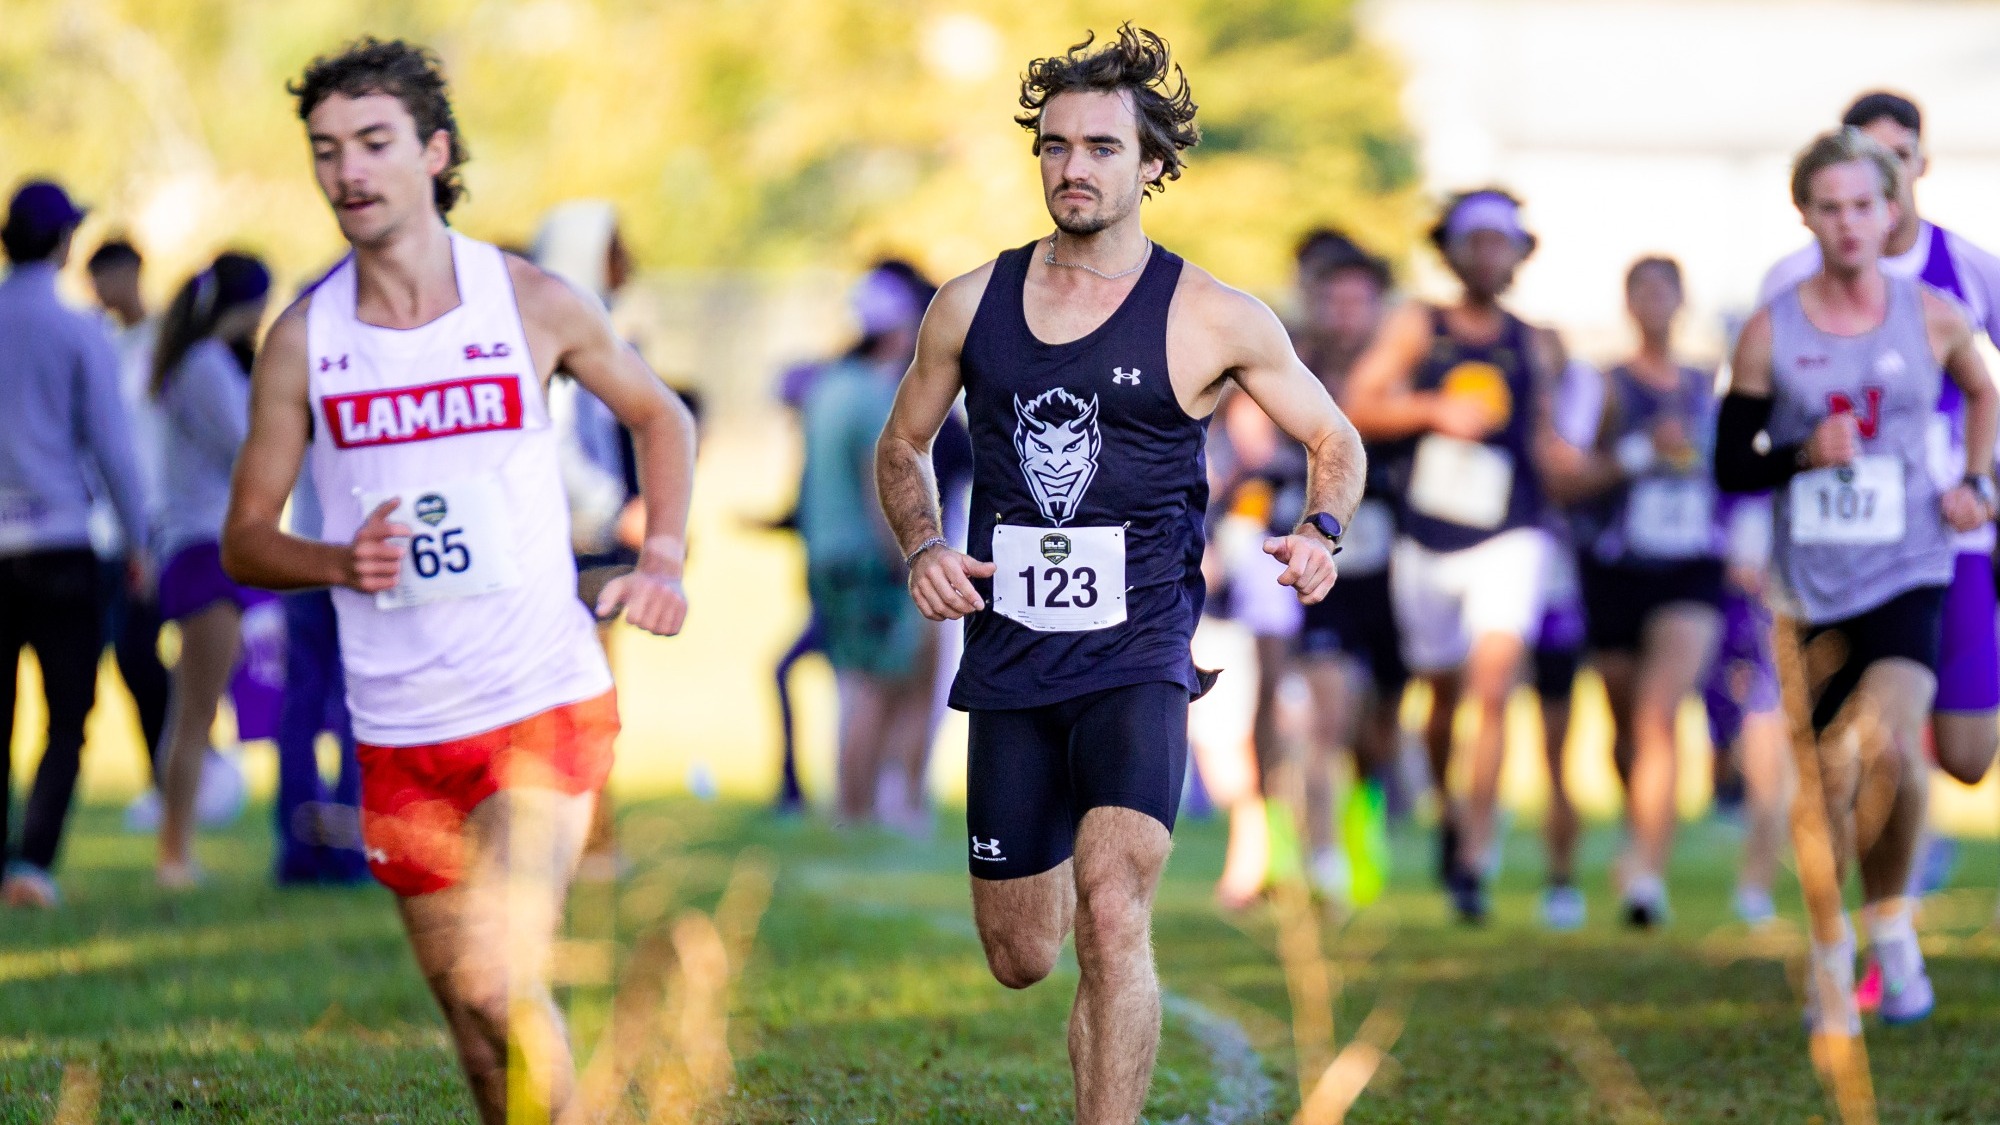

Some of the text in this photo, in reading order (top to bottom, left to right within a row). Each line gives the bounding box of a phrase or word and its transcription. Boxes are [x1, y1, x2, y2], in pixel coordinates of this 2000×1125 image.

[337, 382, 508, 444] LAMAR
[410, 527, 471, 579] 65
[1018, 565, 1099, 609] 123
